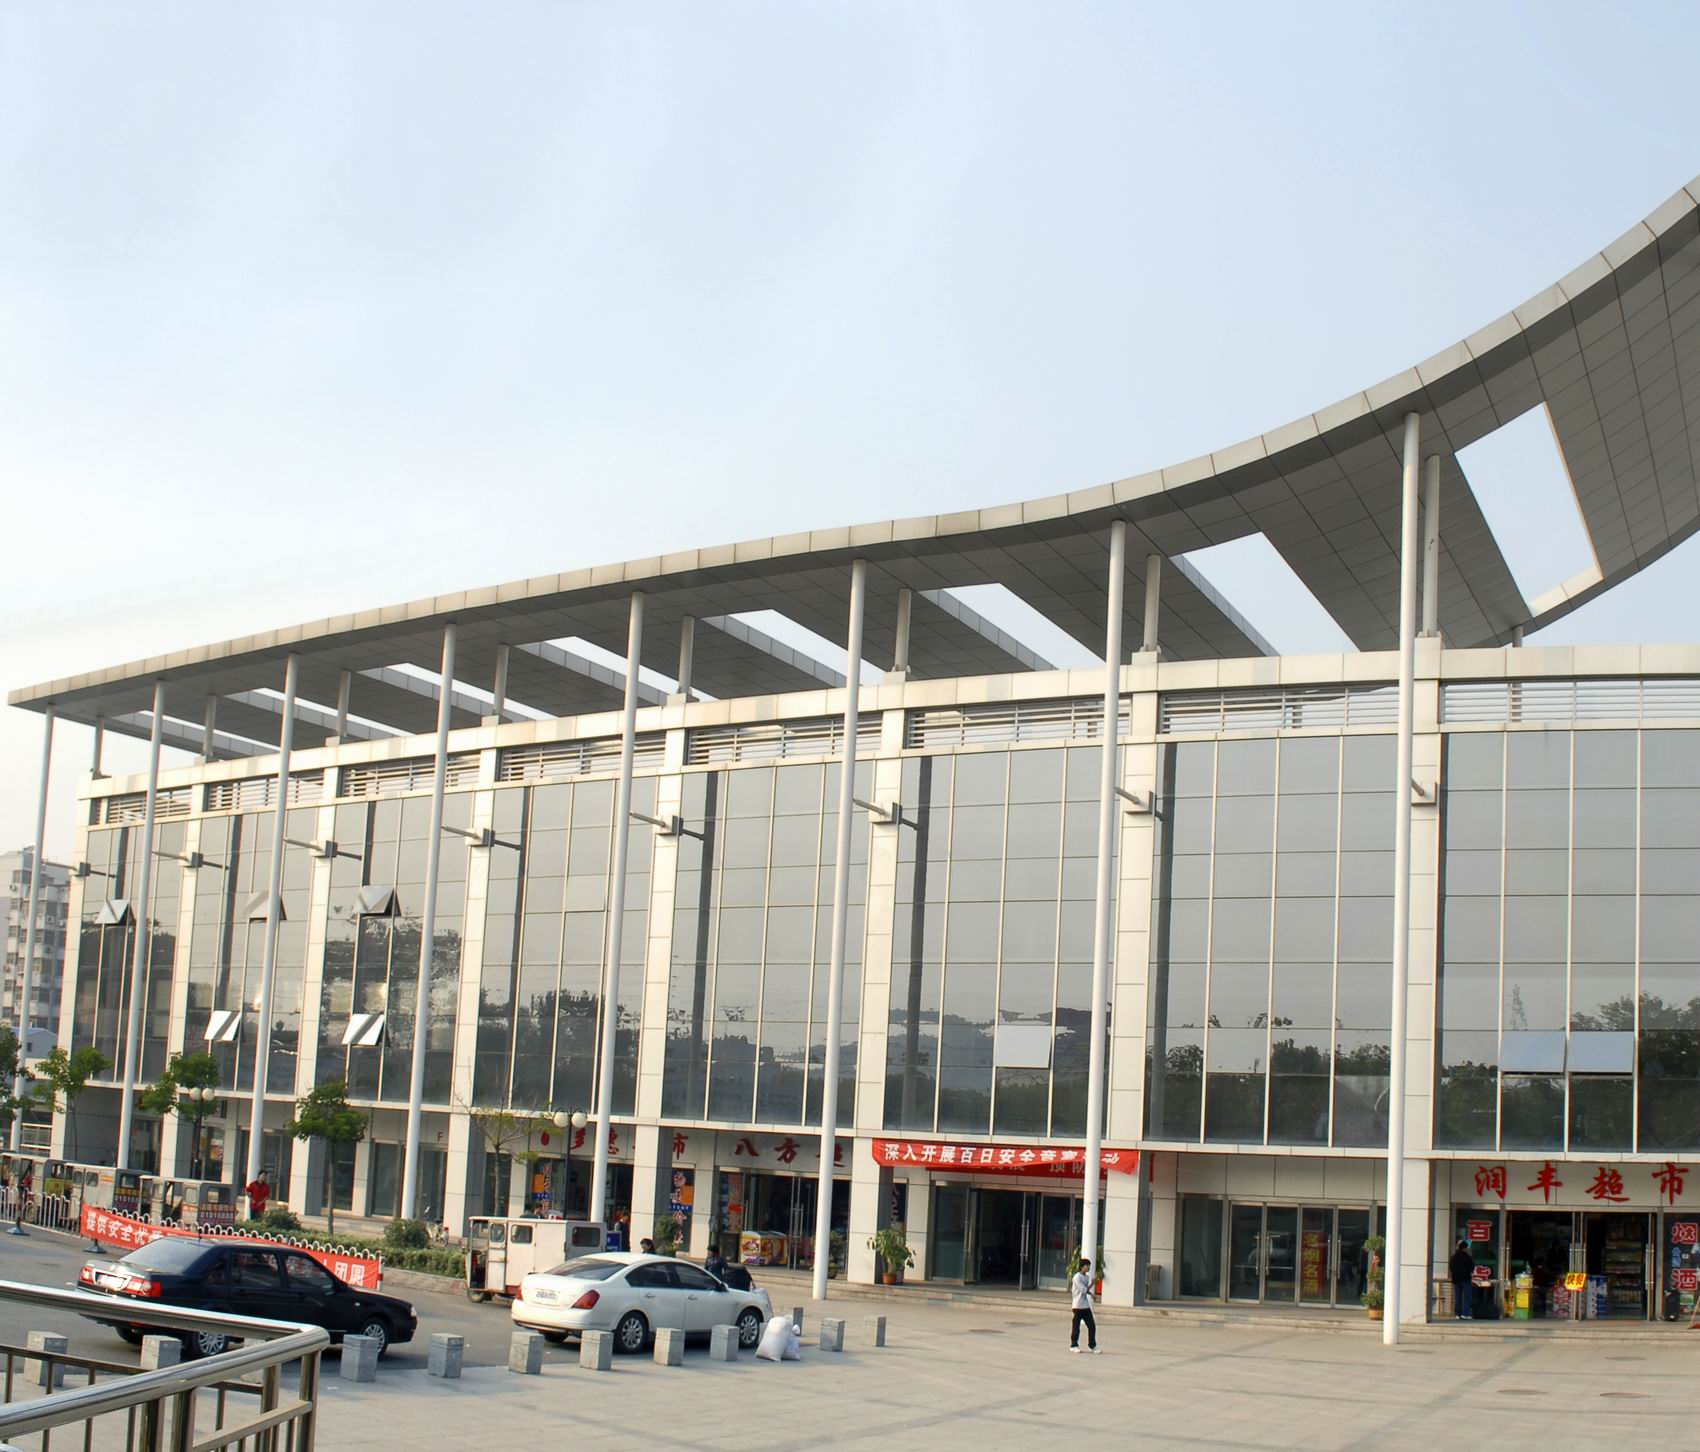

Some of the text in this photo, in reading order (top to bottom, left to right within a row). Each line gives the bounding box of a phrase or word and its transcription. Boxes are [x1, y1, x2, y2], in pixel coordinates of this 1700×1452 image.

[884, 1142, 1120, 1165] 深入开展百日安全竞赛动
[1474, 1160, 1689, 1205] 润丰超市
[1303, 1233, 1319, 1294] 名烟名酒
